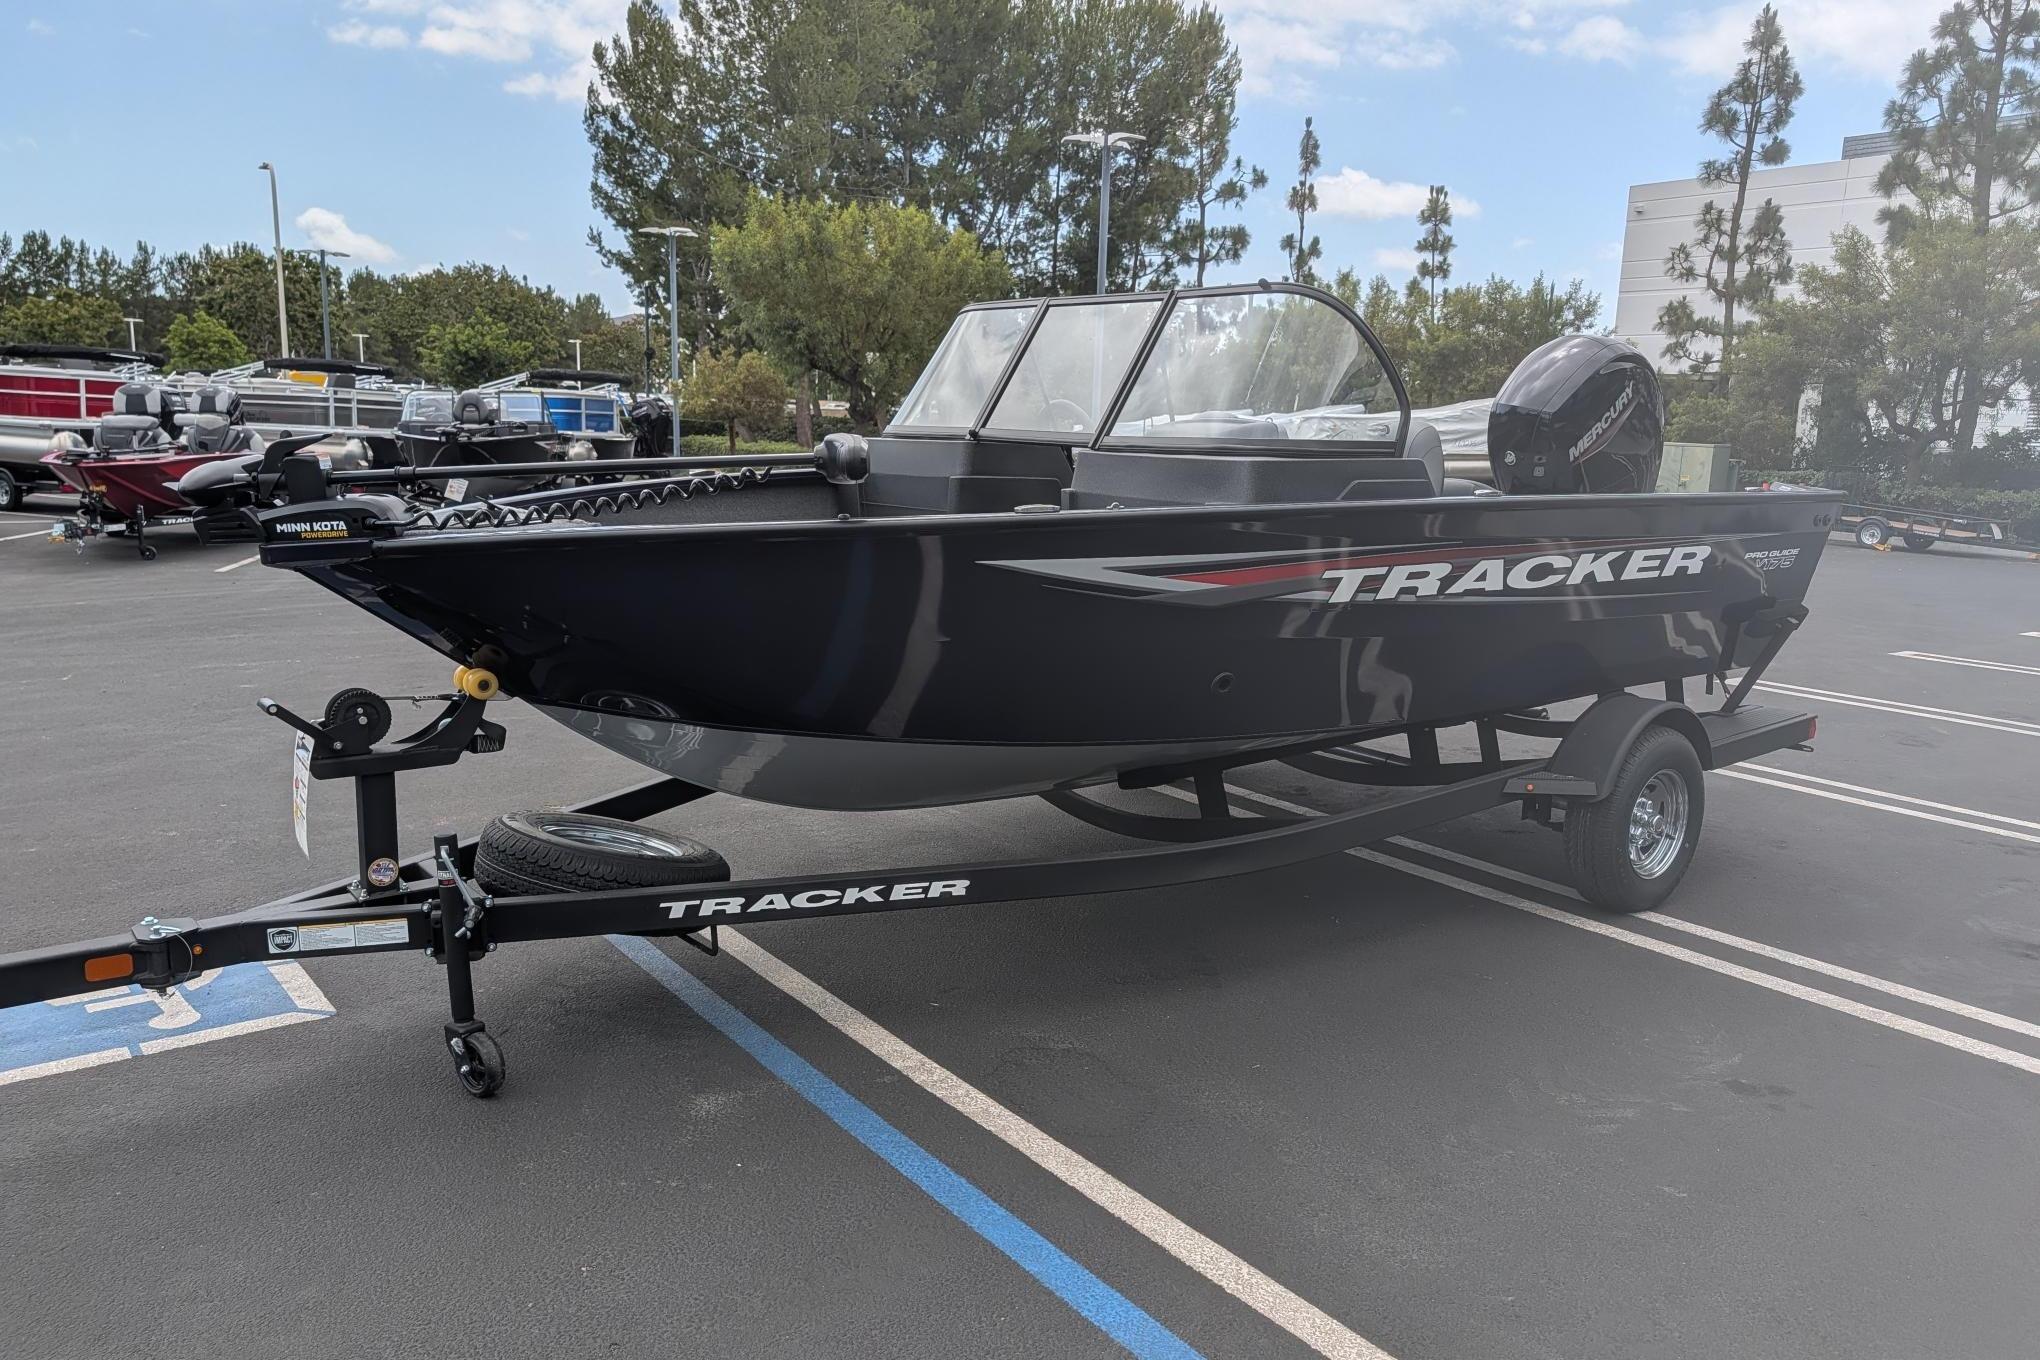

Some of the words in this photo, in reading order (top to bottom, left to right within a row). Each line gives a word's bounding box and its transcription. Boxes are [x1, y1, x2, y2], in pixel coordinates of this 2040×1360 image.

[1568, 380, 1634, 462] MERCURY
[276, 523, 310, 533] MINN
[313, 521, 347, 531] KOTA
[301, 531, 349, 539] POWERDRIVE
[1744, 551, 1768, 560] PRO
[1769, 548, 1800, 557] GUIDE
[1322, 545, 1711, 603] TRACKER
[659, 879, 970, 919] TRACKER
